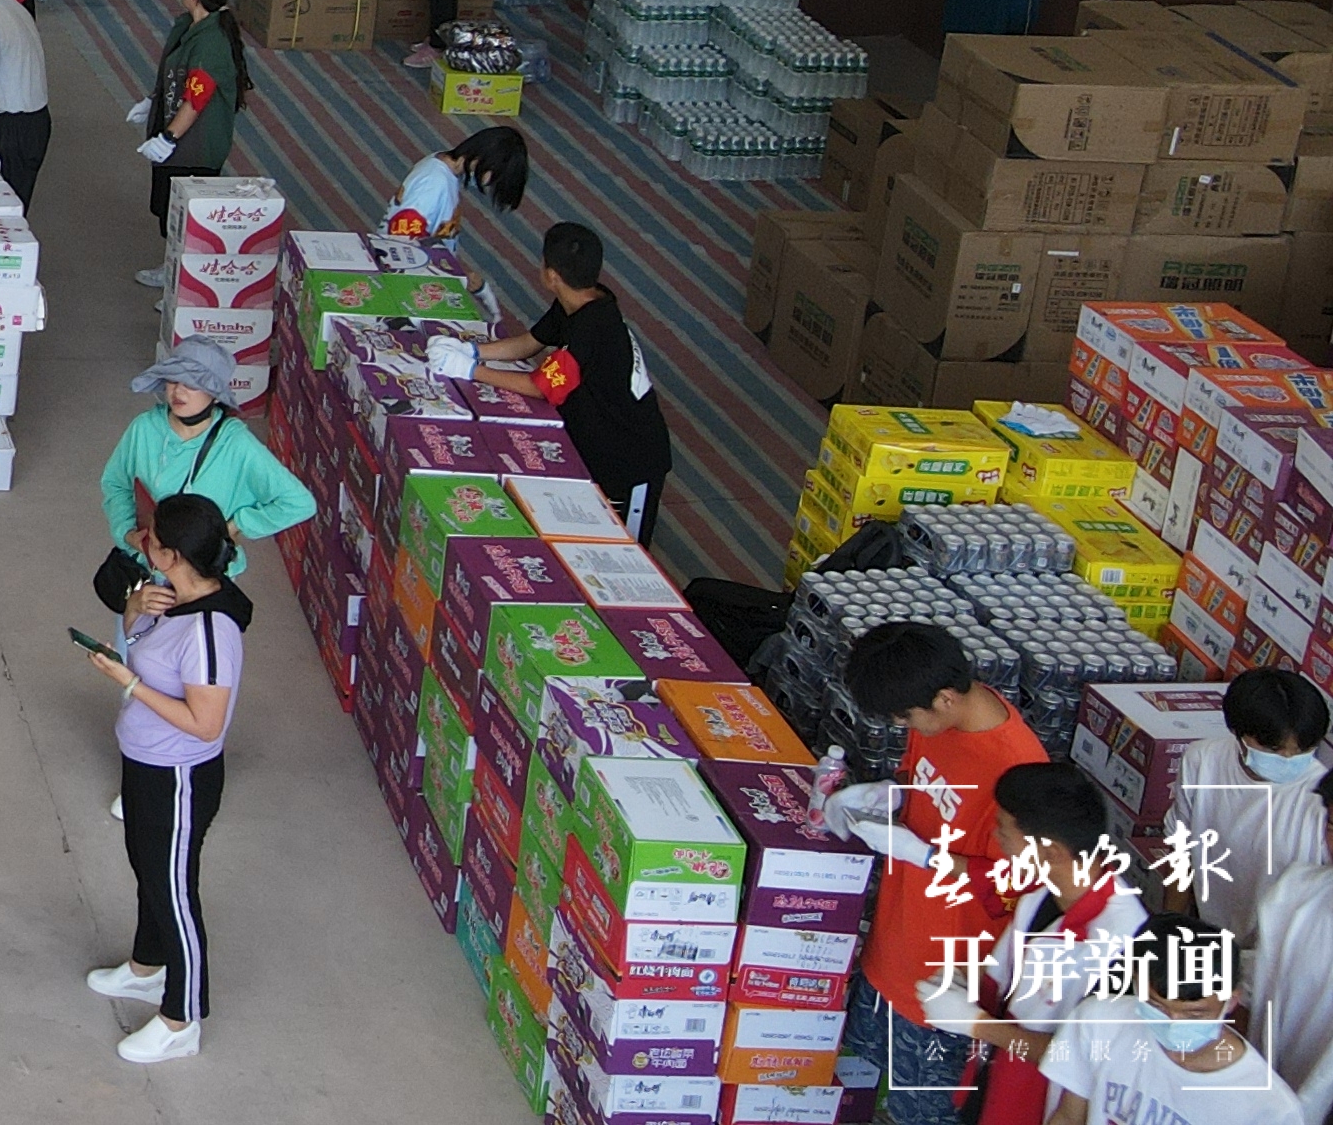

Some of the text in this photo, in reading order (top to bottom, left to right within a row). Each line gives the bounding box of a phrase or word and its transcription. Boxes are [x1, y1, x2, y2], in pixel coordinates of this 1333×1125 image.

[207, 206, 266, 223] 娃哈哈
[199, 258, 259, 275] 娃哈哈
[192, 319, 254, 334] Wahaha
